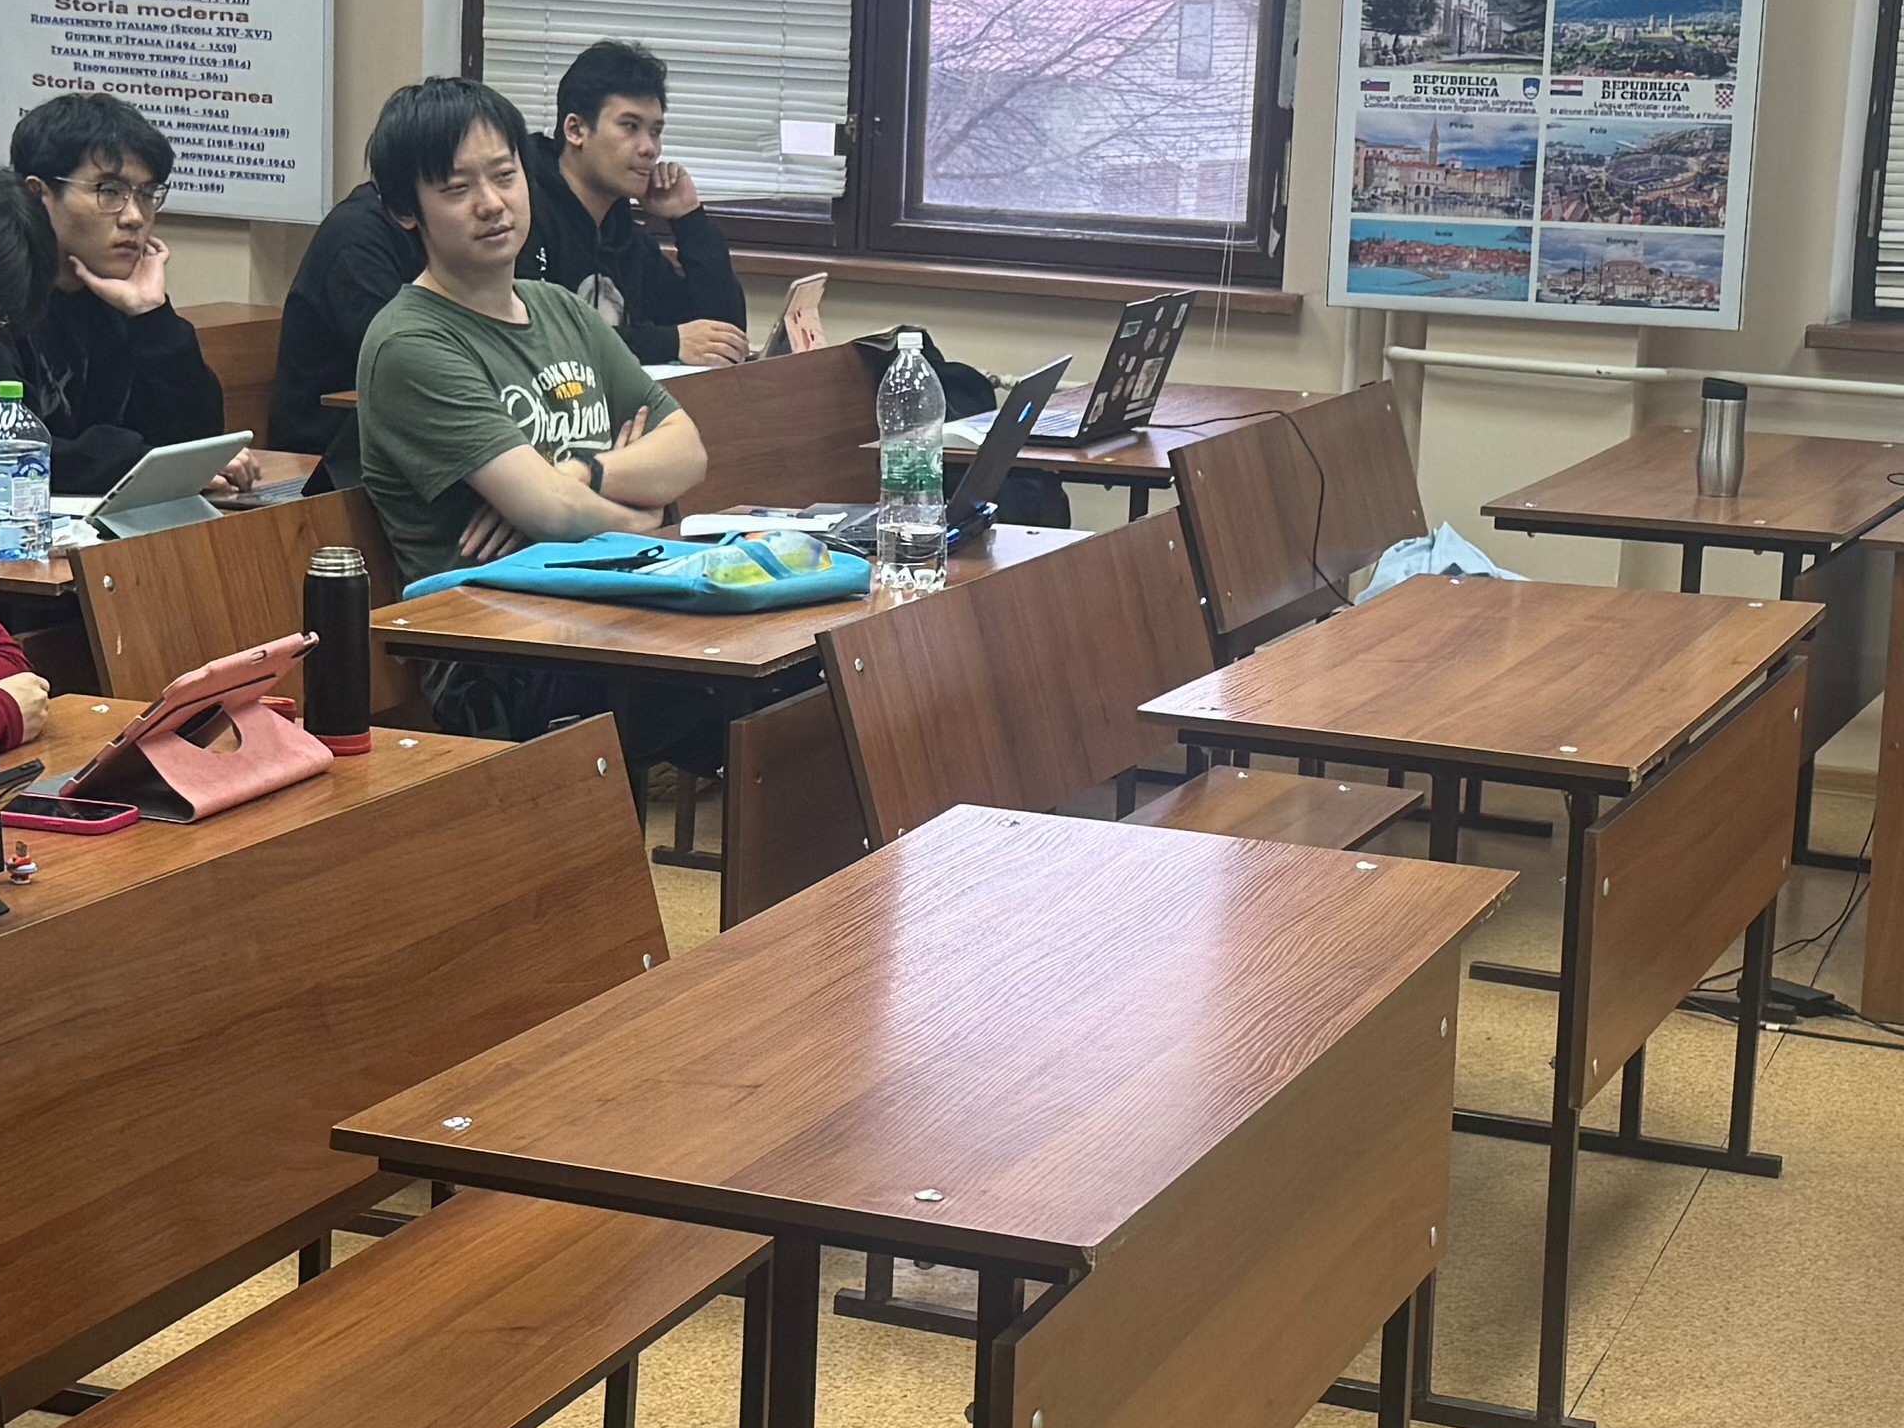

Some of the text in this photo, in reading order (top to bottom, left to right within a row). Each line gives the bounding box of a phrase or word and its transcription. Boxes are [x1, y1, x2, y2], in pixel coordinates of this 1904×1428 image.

[137, 3, 249, 23] moderna
[1412, 75, 1498, 87] REPUBBLICA
[1601, 80, 1690, 92] REPUBBLICA
[31, 73, 273, 105] Storia contemporanea
[1414, 85, 1500, 97] DI SLOVENIA
[1601, 91, 1682, 102] DI CROAZIA
